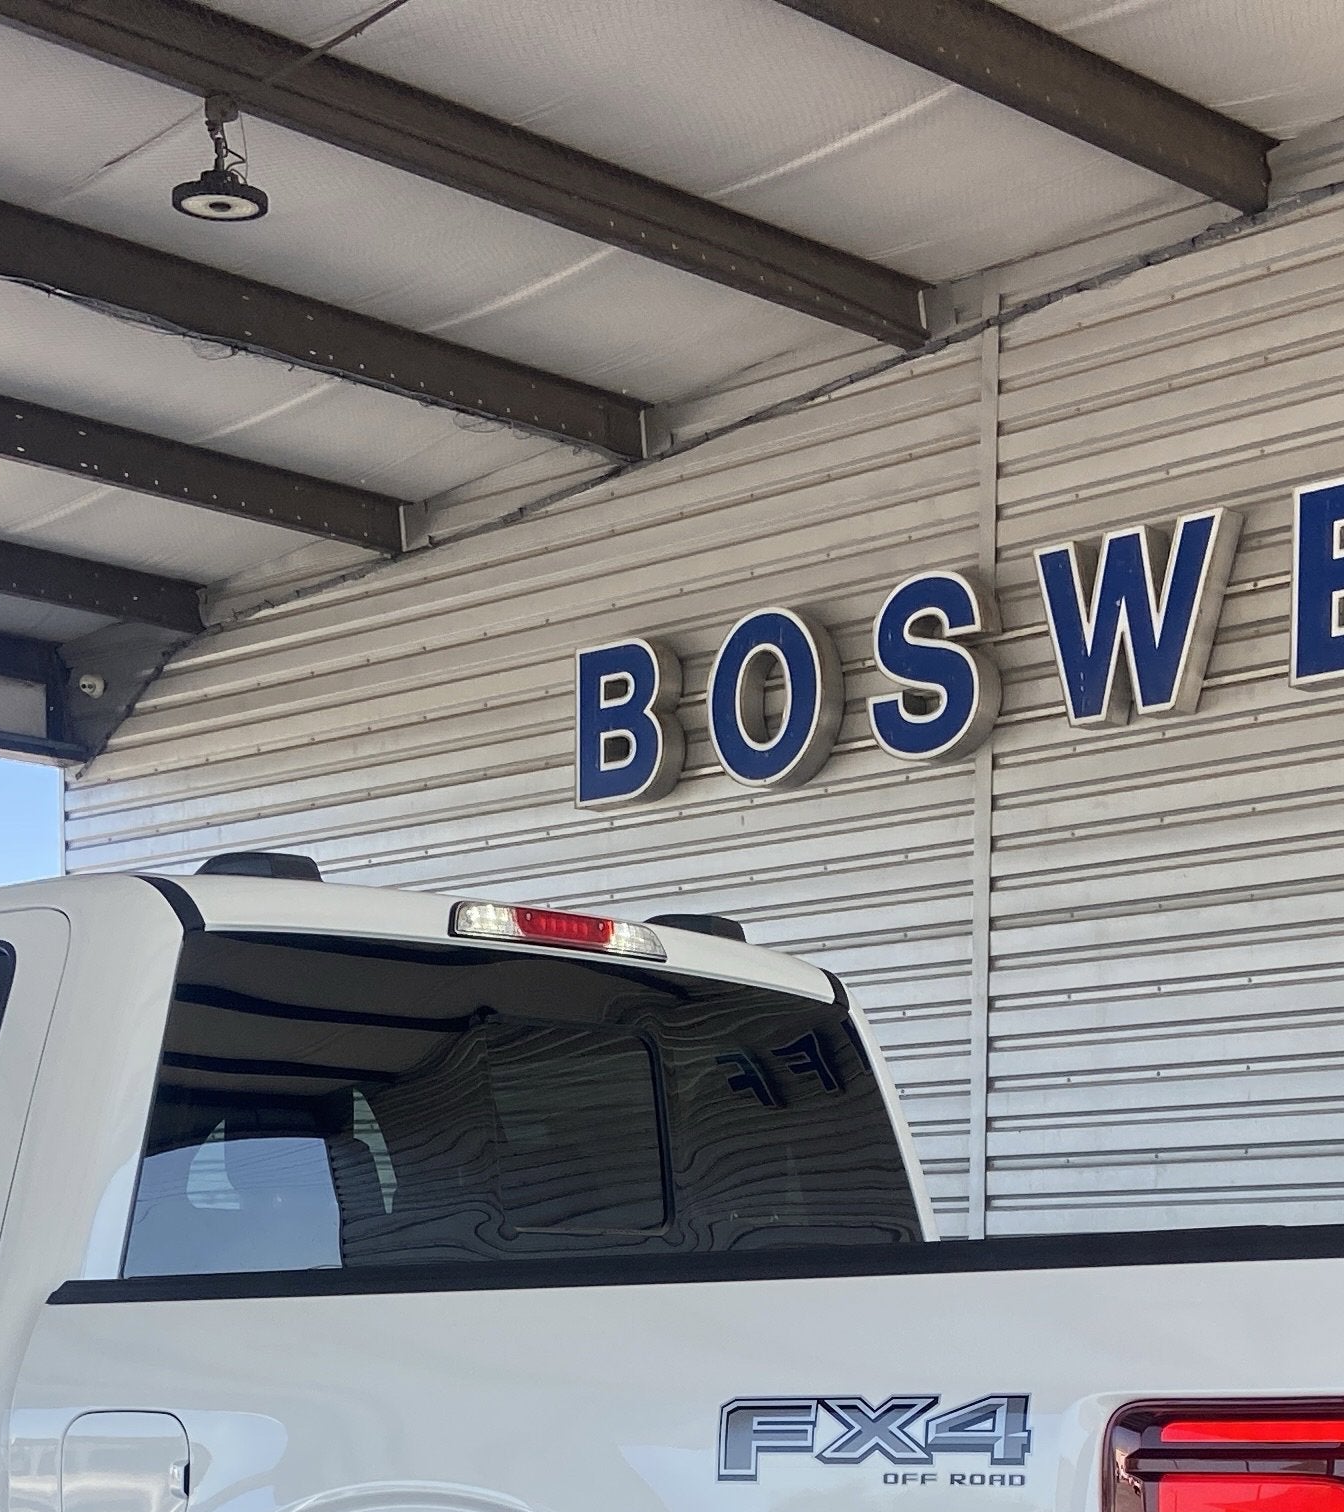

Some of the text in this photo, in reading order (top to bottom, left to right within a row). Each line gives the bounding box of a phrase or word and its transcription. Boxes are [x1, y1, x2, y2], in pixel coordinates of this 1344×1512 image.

[717, 1393, 1032, 1482] FX4
[883, 1473, 1026, 1486] OFF ROAD
